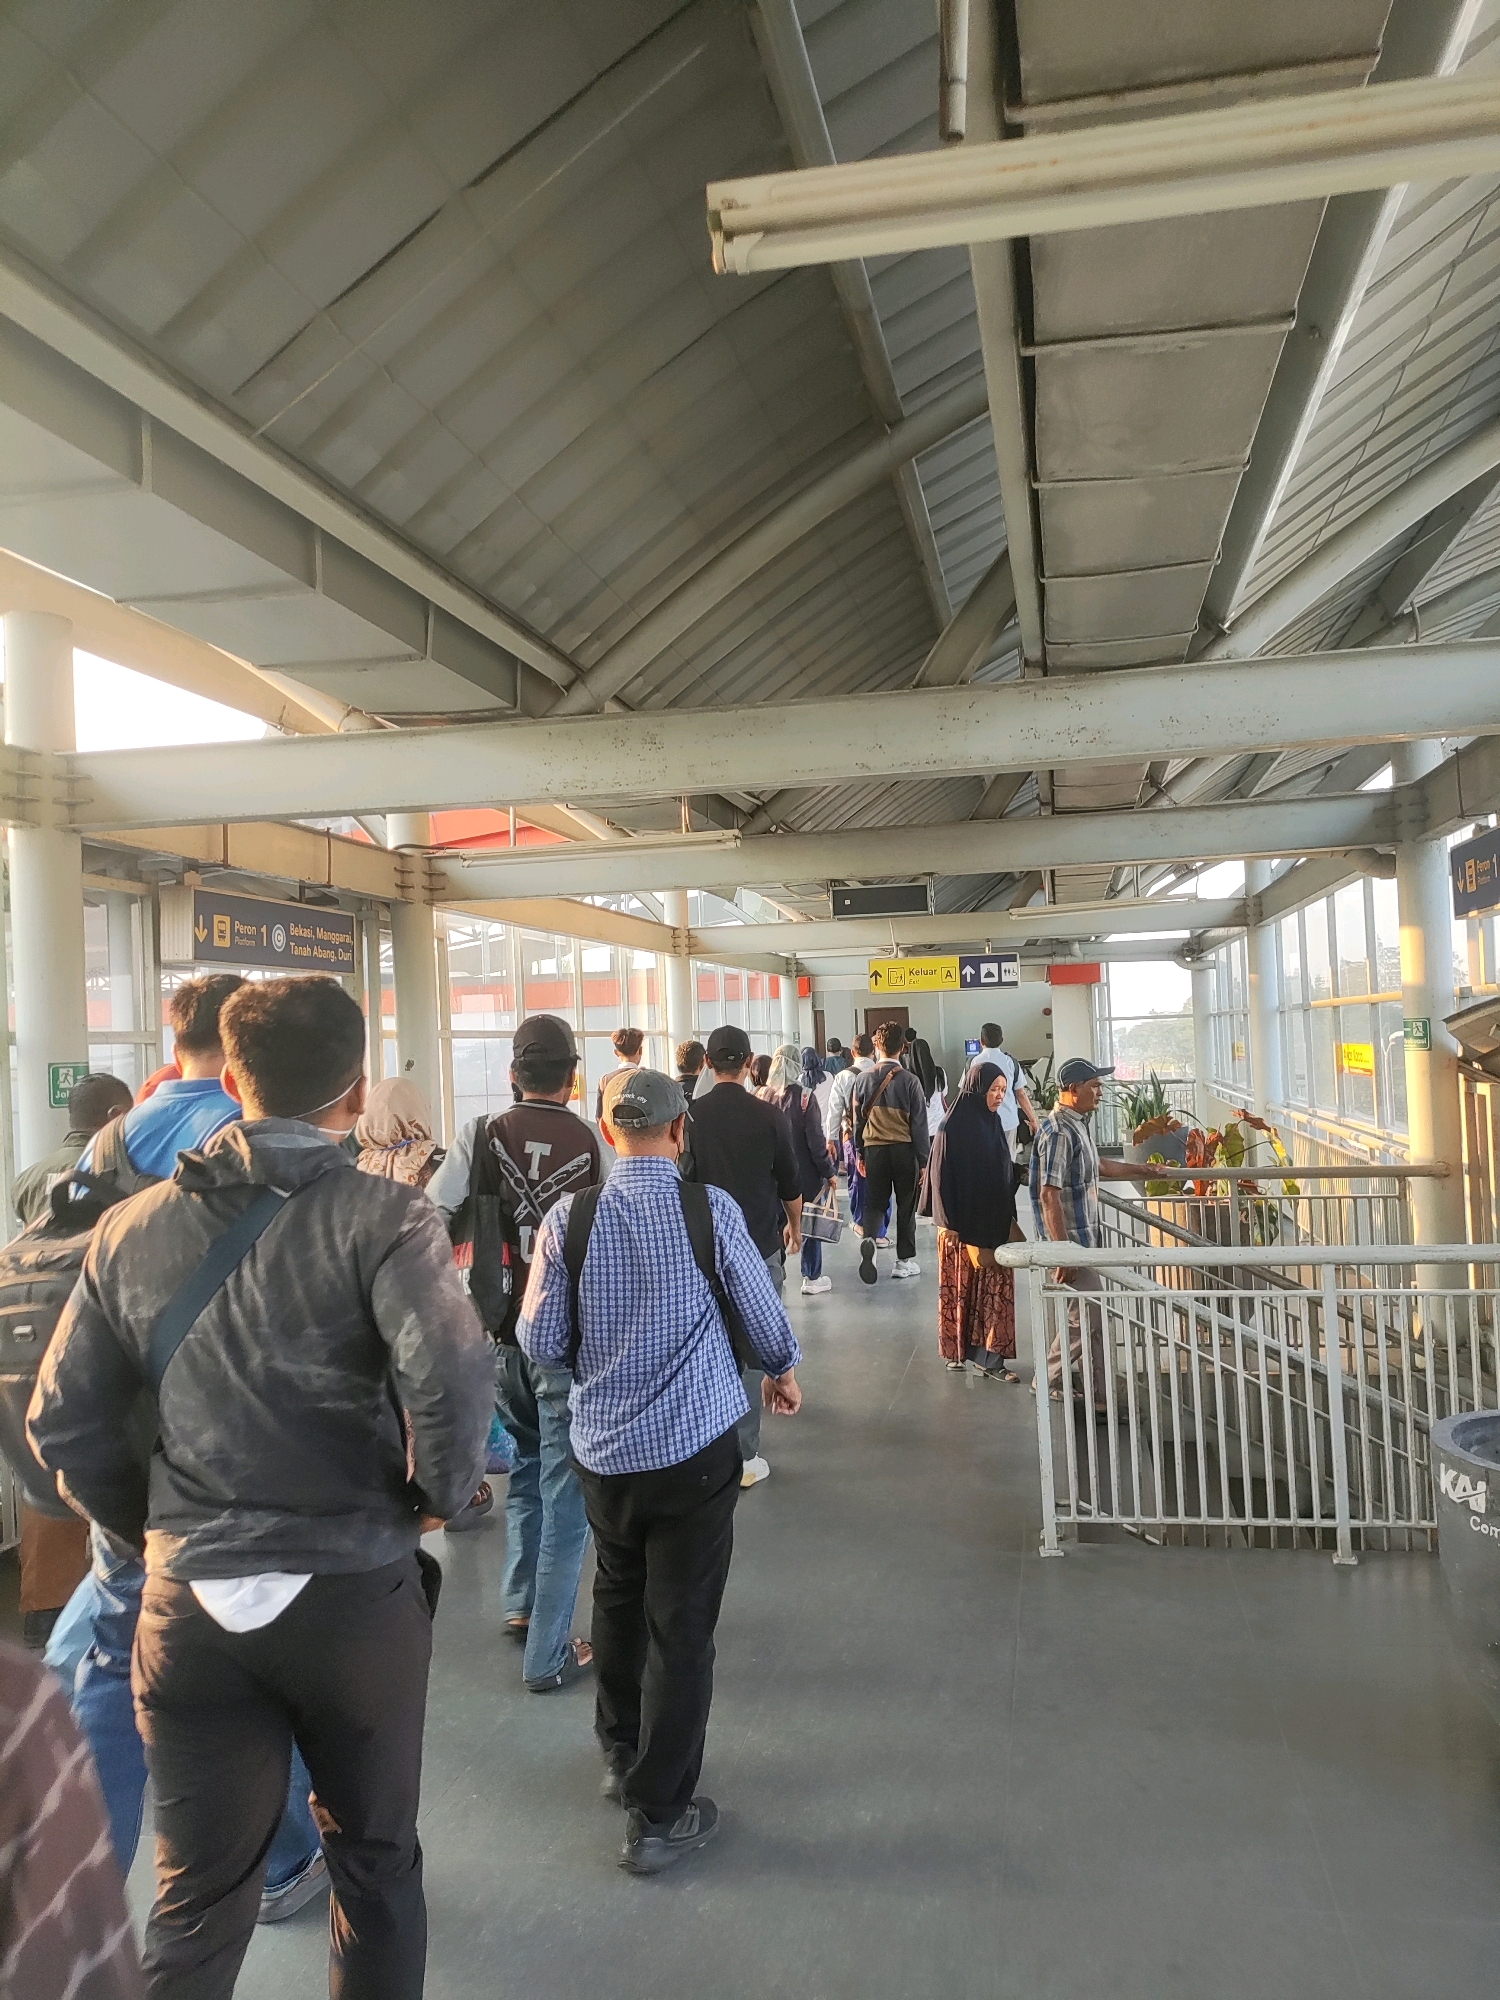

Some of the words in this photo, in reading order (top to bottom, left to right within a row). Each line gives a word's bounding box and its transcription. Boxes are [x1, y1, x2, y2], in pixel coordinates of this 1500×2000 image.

[234, 920, 257, 936] Peron
[260, 924, 267, 947] 1
[234, 937, 256, 947] Platform
[289, 923, 315, 941] Bekasi,
[316, 927, 354, 946] Manggarai,
[289, 942, 312, 957] Tanah
[312, 946, 337, 963] Abang,
[338, 950, 352, 962] Duri
[908, 967, 938, 977] Keluar
[944, 969, 953, 980] A
[523, 1140, 553, 1181] T
[1440, 1462, 1487, 1514] KAI
